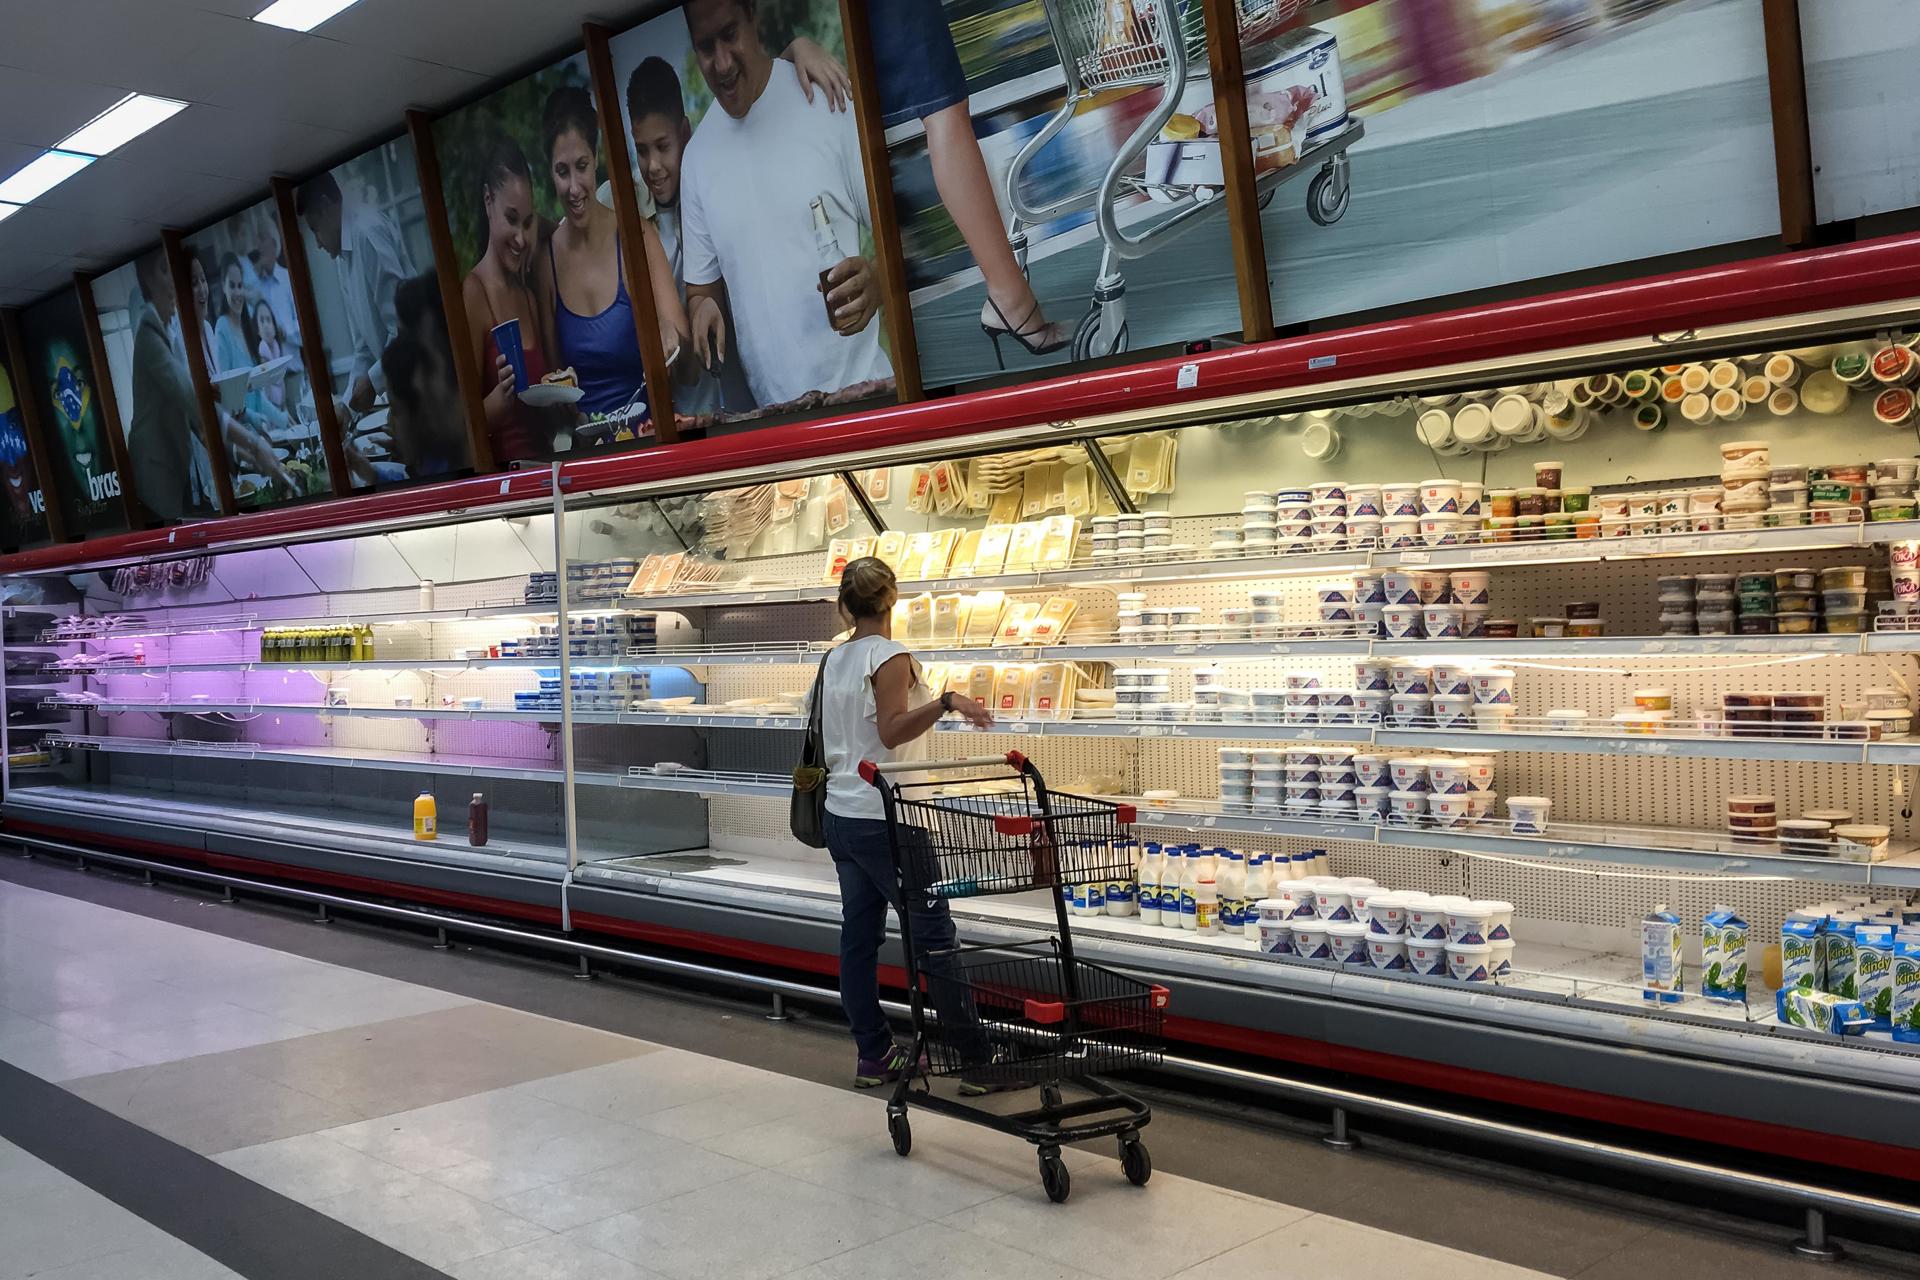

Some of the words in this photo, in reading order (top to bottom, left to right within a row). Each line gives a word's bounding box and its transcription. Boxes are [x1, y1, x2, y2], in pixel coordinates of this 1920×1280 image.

[86, 467, 121, 501] bras
[28, 489, 46, 514] ve
[1784, 943, 1812, 961] Kindy
[1860, 956, 1891, 976] Kindy
